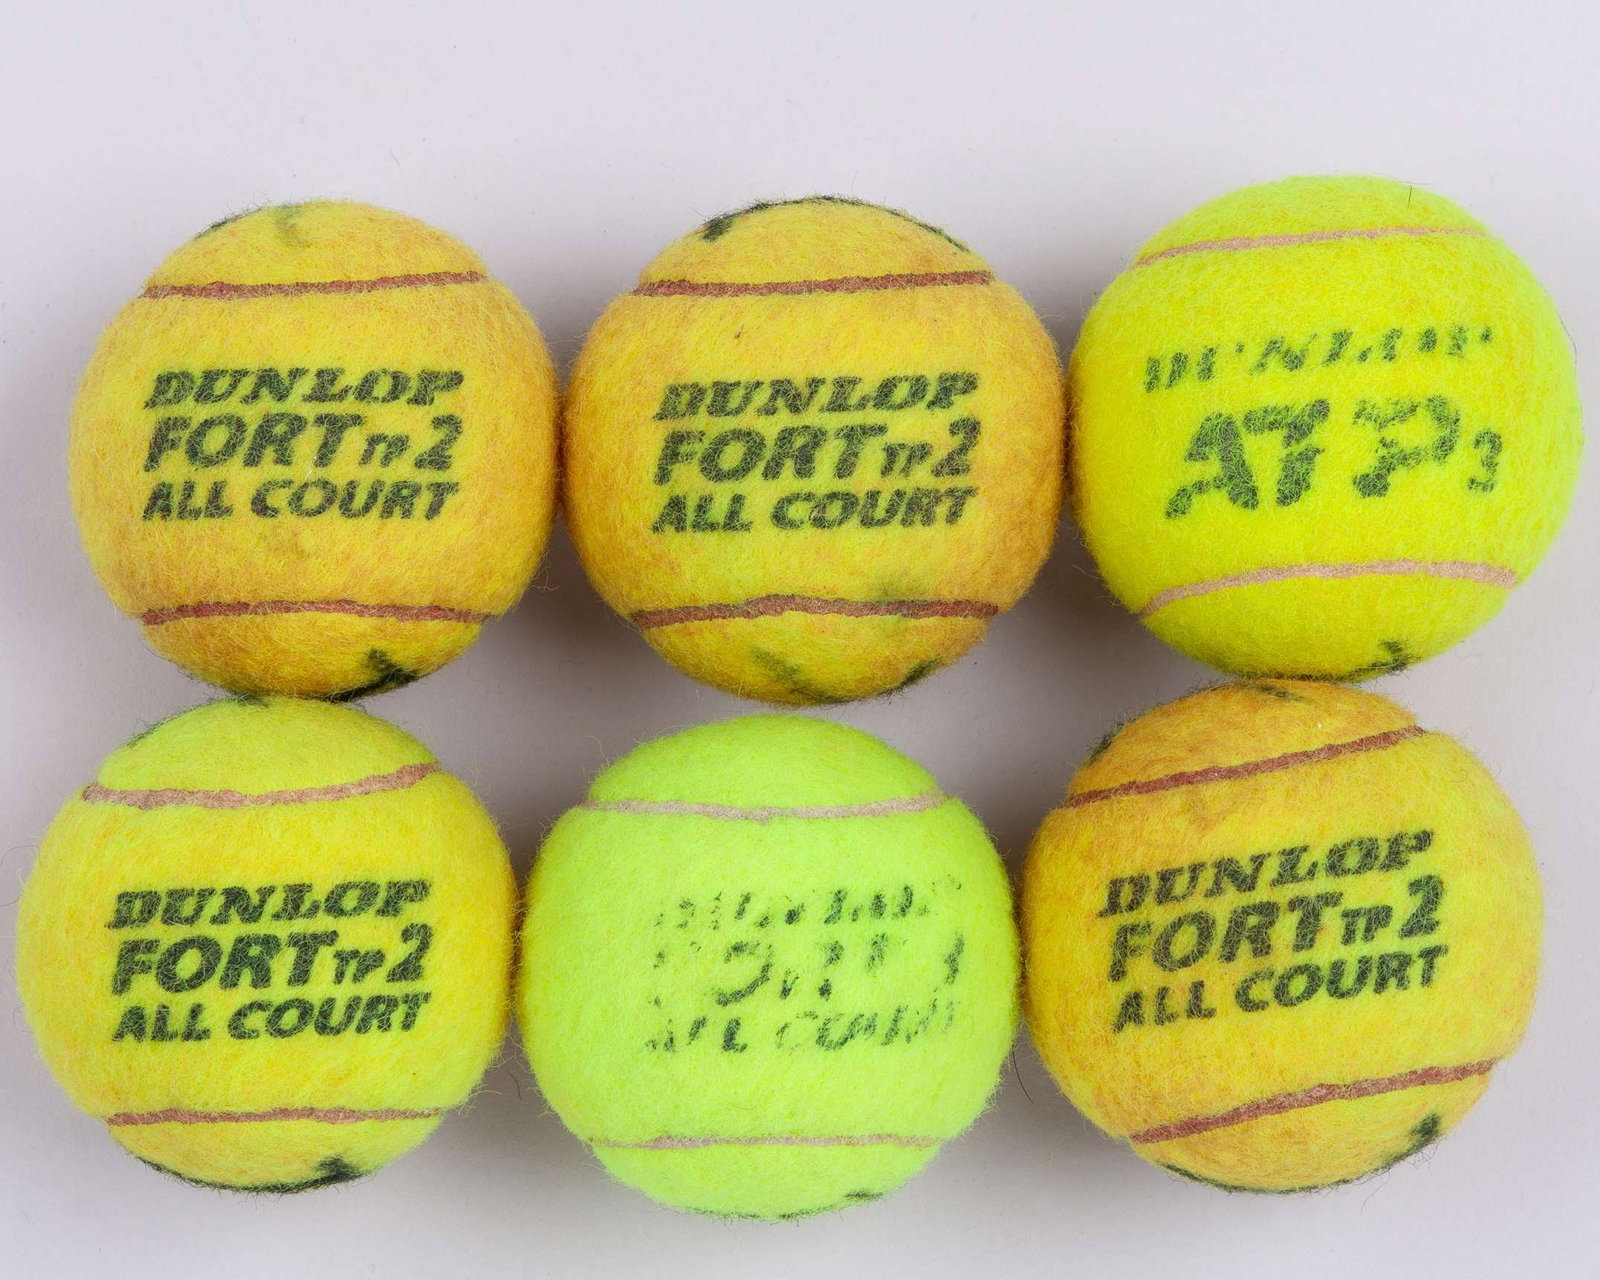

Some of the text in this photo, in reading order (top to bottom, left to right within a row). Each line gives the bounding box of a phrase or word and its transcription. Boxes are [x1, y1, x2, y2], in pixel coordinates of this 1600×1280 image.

[144, 367, 464, 409] DUNLOP
[652, 372, 979, 421] DUNLOP
[144, 413, 366, 472] FORT
[414, 414, 463, 471] 2
[653, 424, 888, 486] FORT
[930, 417, 981, 478] 2
[1165, 395, 1502, 519] ATP 3
[142, 477, 459, 521] ALL COURT
[651, 486, 979, 534] ALL COURT
[1096, 830, 1434, 917] DUNLOP
[105, 879, 431, 930] DUNLOP
[1107, 891, 1343, 982] FORT
[1398, 874, 1445, 938] 2
[111, 930, 339, 996] FORT
[386, 923, 433, 983] 2
[112, 992, 432, 1043] ALL COURT
[1113, 945, 1448, 1034] ALL COURT
